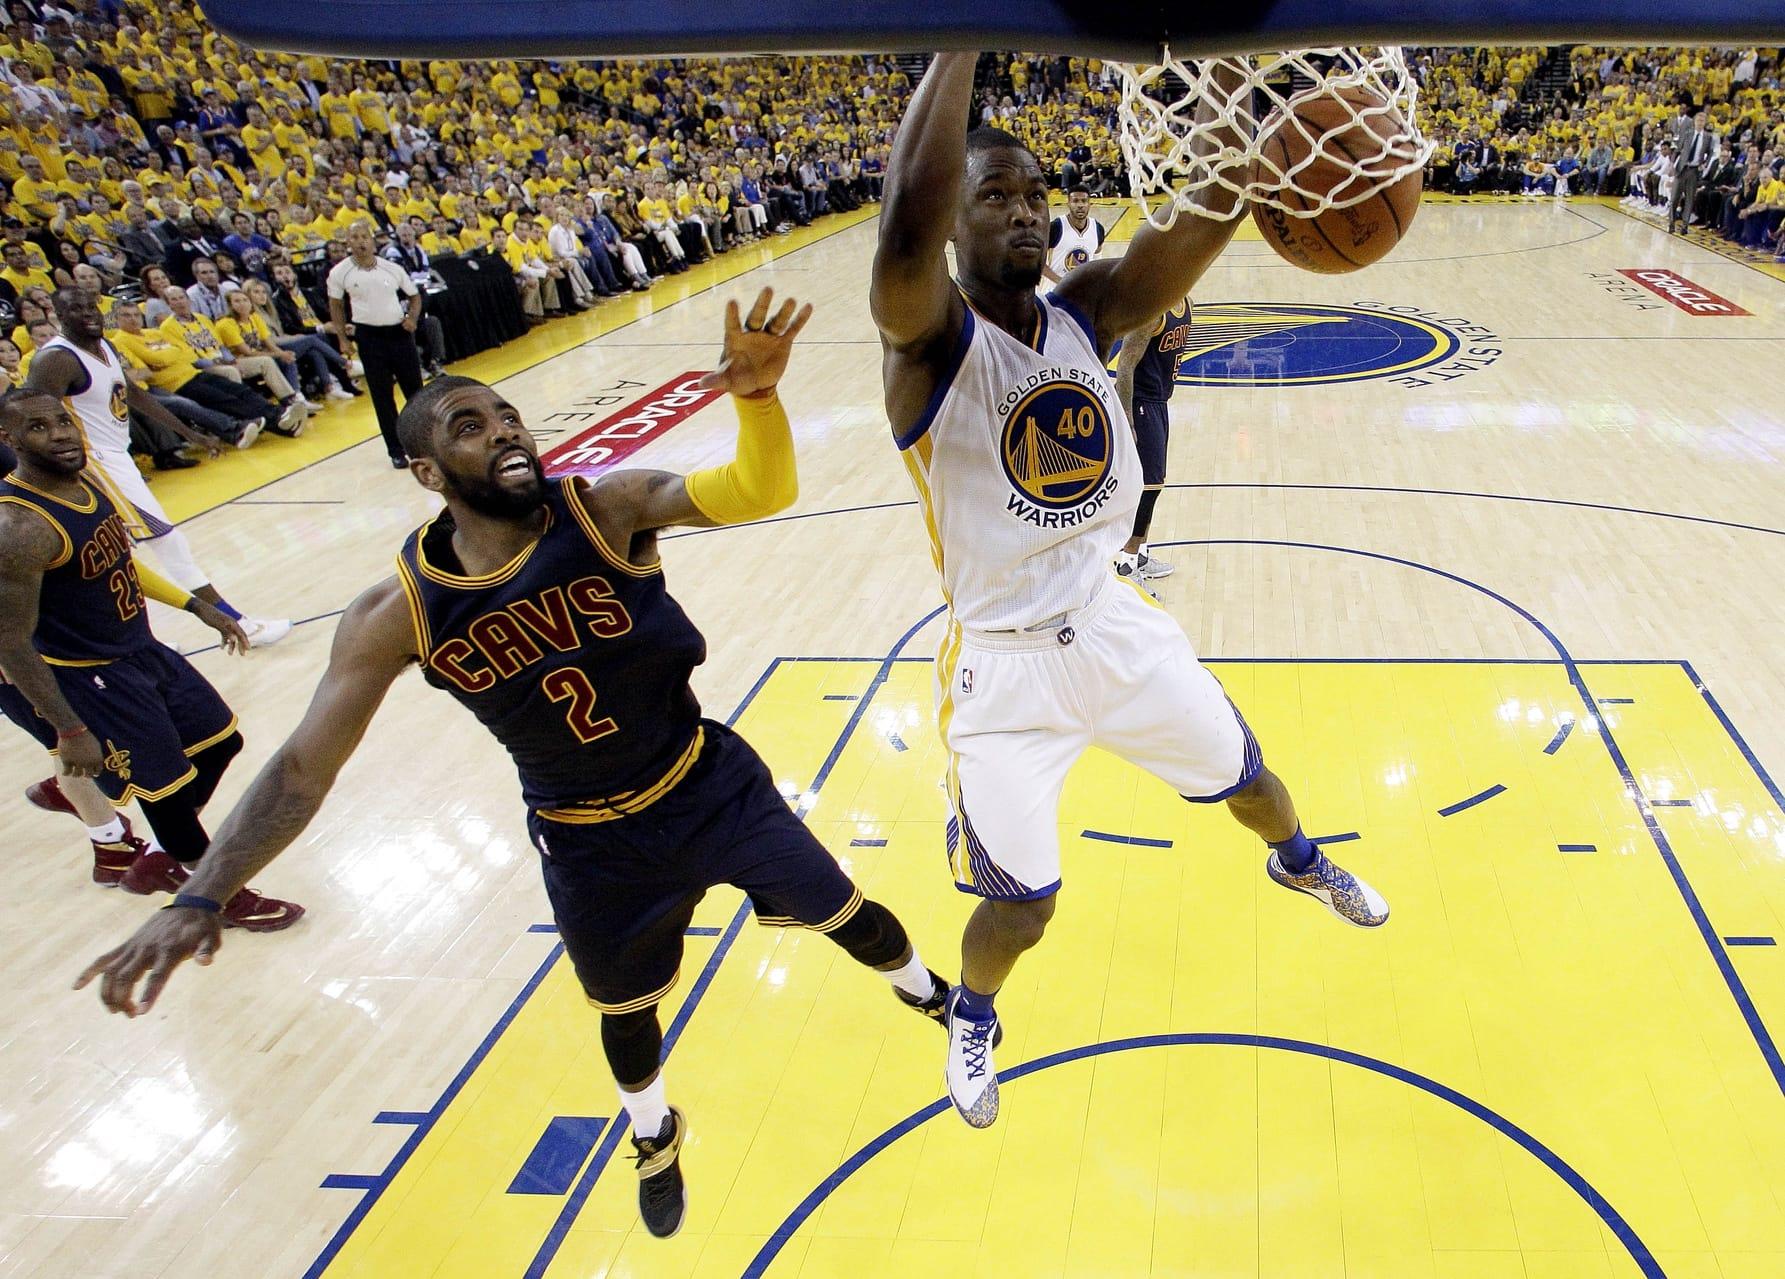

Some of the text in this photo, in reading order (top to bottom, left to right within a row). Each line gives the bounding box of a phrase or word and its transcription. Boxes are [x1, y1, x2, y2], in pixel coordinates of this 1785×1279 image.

[1584, 272, 1665, 311] ARENA
[1637, 272, 1731, 312] ORACLE
[1159, 324, 1191, 352] CAV
[1352, 301, 1502, 343] GOLDEN
[1388, 347, 1503, 389] STATE
[528, 379, 647, 442] AREN
[997, 367, 1110, 417] GOLDEN STATE
[1057, 405, 1095, 439] 40
[1006, 475, 1119, 529] WARRIORS
[82, 513, 129, 579] CAV
[430, 575, 633, 693] CAVS
[542, 666, 620, 744] 2
